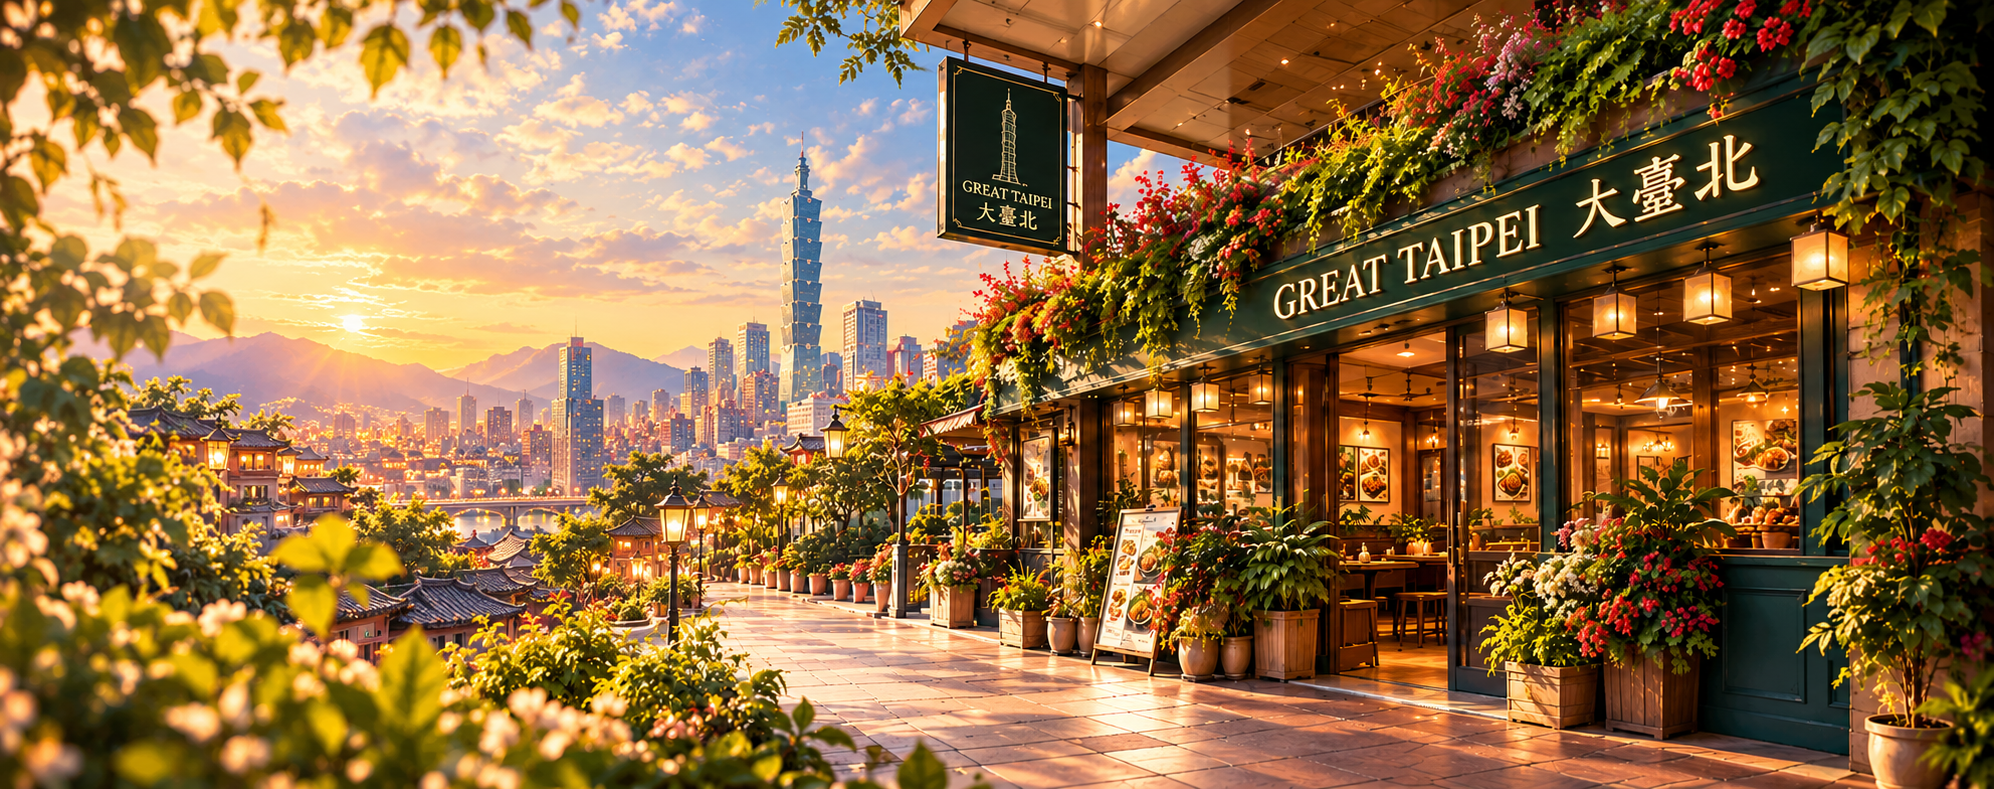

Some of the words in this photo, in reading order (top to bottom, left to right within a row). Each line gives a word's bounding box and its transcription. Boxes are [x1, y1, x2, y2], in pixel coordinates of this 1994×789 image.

[962, 180, 1008, 200] GREAT
[1011, 190, 1052, 209] TAIPEI
[1273, 254, 1387, 320] GREAT
[1397, 203, 1543, 284] TAIPEI
[1573, 134, 1759, 239] 大臺北
